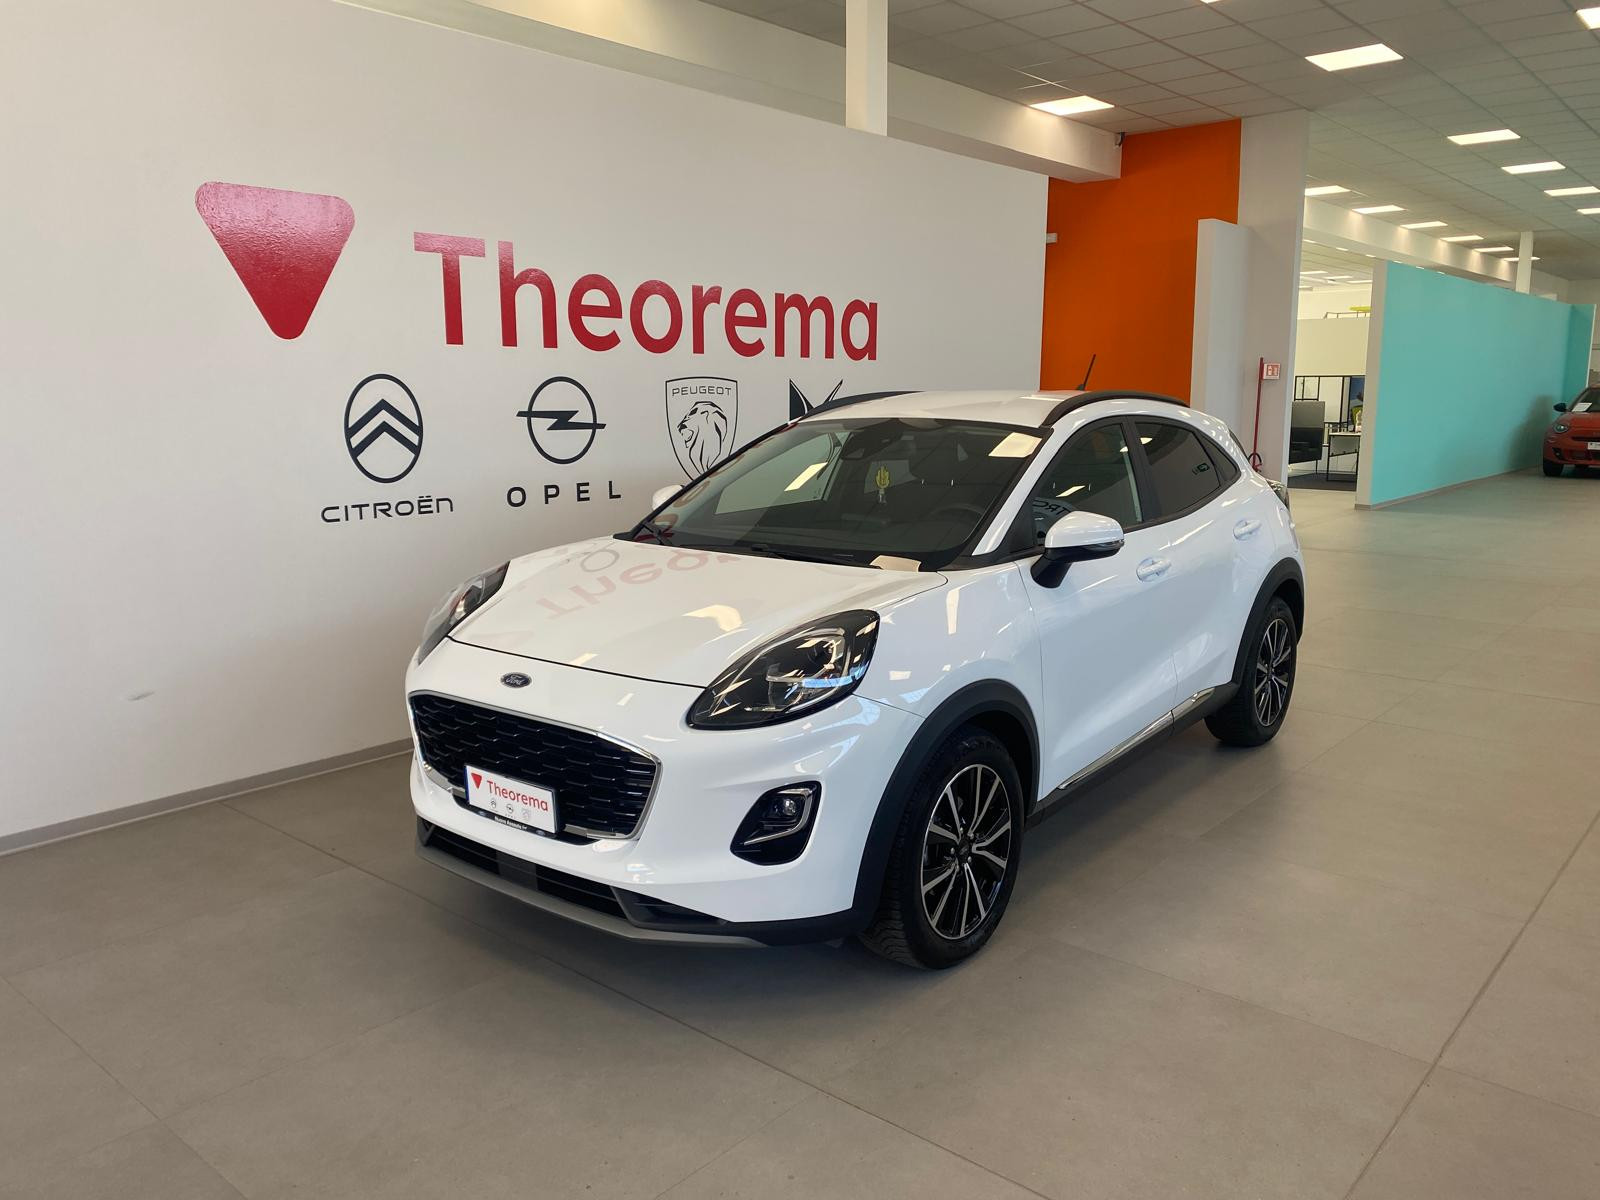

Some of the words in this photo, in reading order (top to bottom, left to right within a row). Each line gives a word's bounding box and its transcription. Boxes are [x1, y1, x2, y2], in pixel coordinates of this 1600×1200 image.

[413, 231, 878, 361] Theorema
[671, 385, 732, 397] PEUGEOT
[506, 480, 622, 508] OPEL
[487, 780, 549, 812] Theorema
